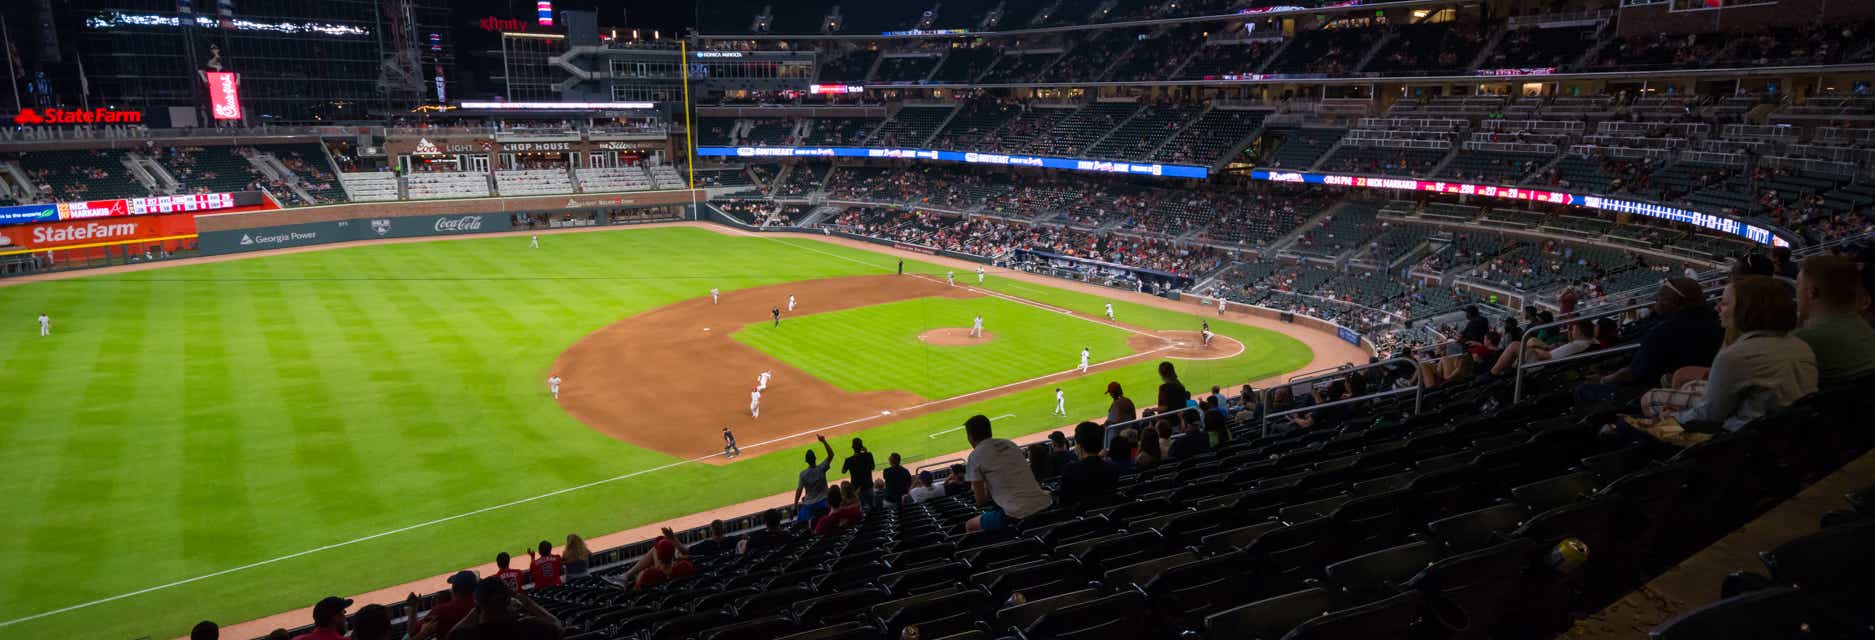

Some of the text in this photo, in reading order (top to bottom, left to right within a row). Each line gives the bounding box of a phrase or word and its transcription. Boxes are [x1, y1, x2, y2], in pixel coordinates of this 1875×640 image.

[480, 16, 528, 32] xfinity
[1357, 178, 1366, 186] 22
[1367, 178, 1382, 187] NICK
[1383, 179, 1417, 190] MARKAKIS
[70, 202, 89, 211] NICK
[71, 208, 110, 218] MARKAKIS
[434, 215, 482, 232] Coca-Cola
[255, 232, 316, 243] Georgia Power
